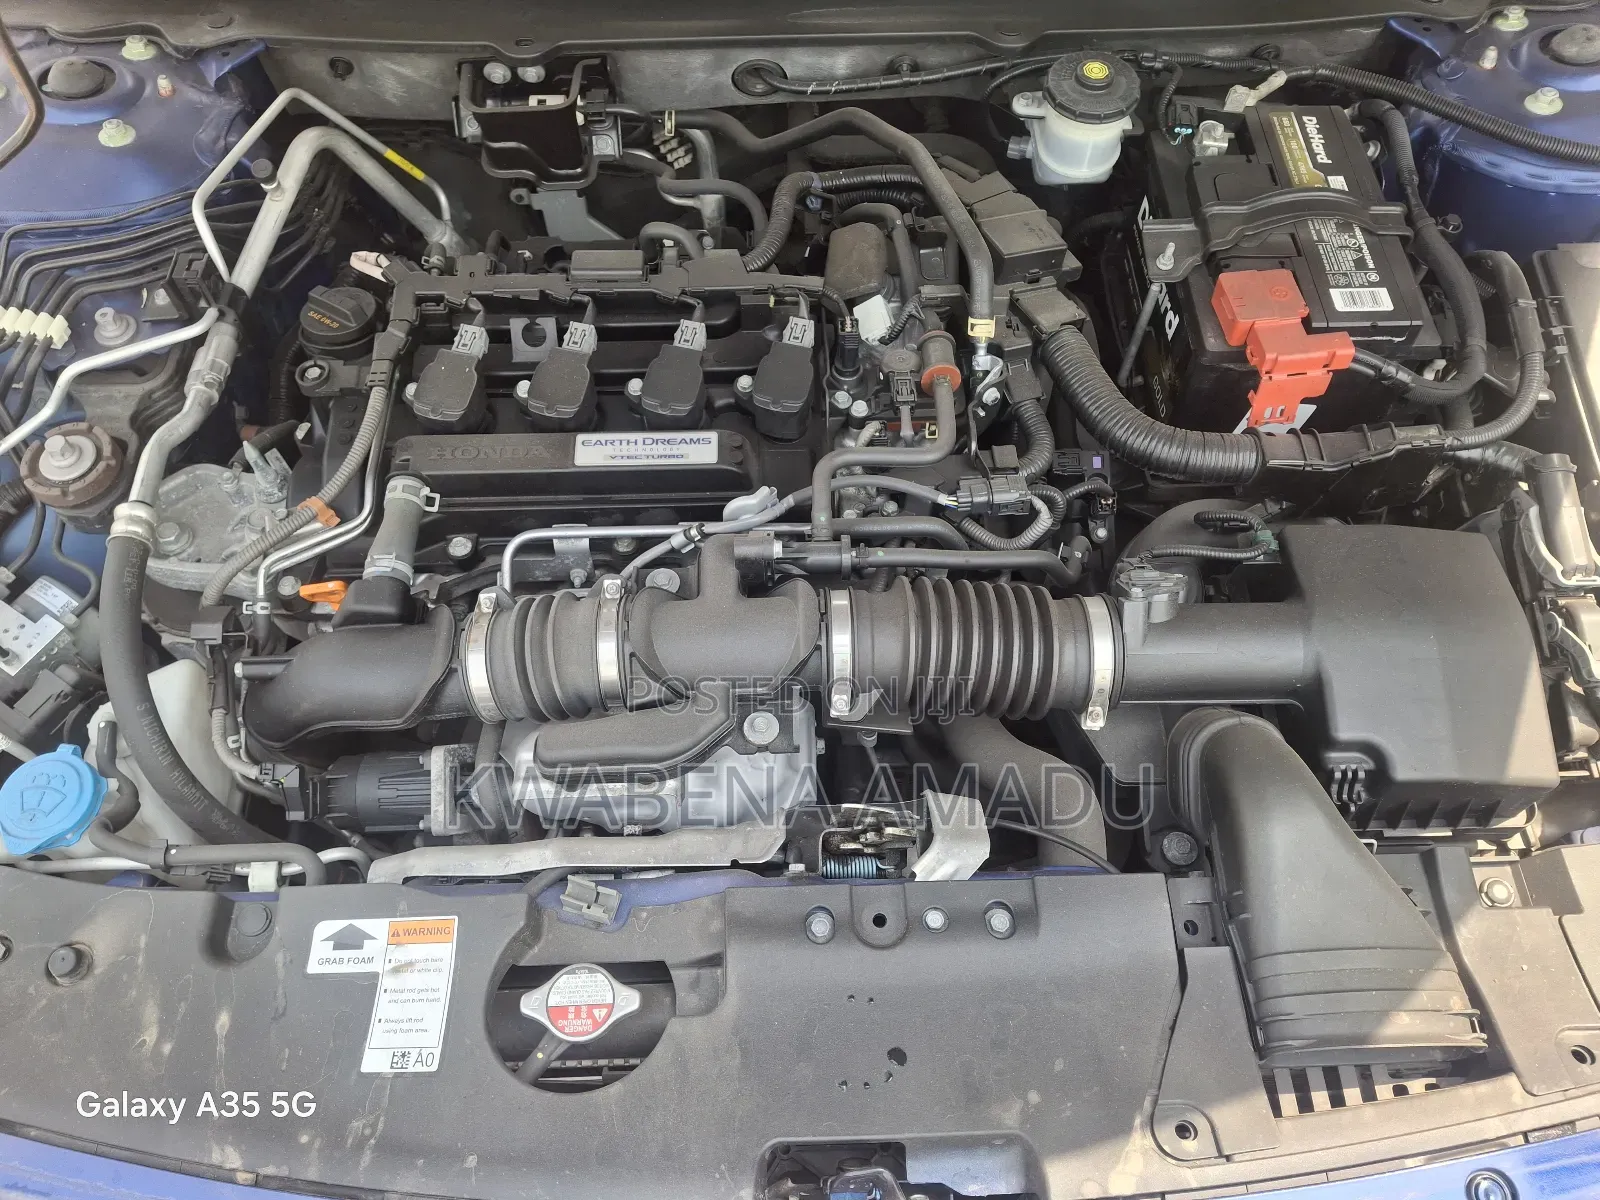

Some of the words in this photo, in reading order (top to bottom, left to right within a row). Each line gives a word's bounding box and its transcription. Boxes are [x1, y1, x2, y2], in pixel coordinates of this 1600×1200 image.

[1302, 115, 1333, 164] DieHard
[308, 311, 322, 320] SAE
[1153, 375, 1166, 418] GOLD
[581, 438, 638, 447] EARTH
[642, 437, 712, 446] DREAMS
[402, 926, 451, 937] WARNING
[317, 957, 344, 966] GRAB
[347, 956, 374, 965] FOAM
[564, 1025, 592, 1033] DANGER
[412, 1051, 435, 1068] A0
